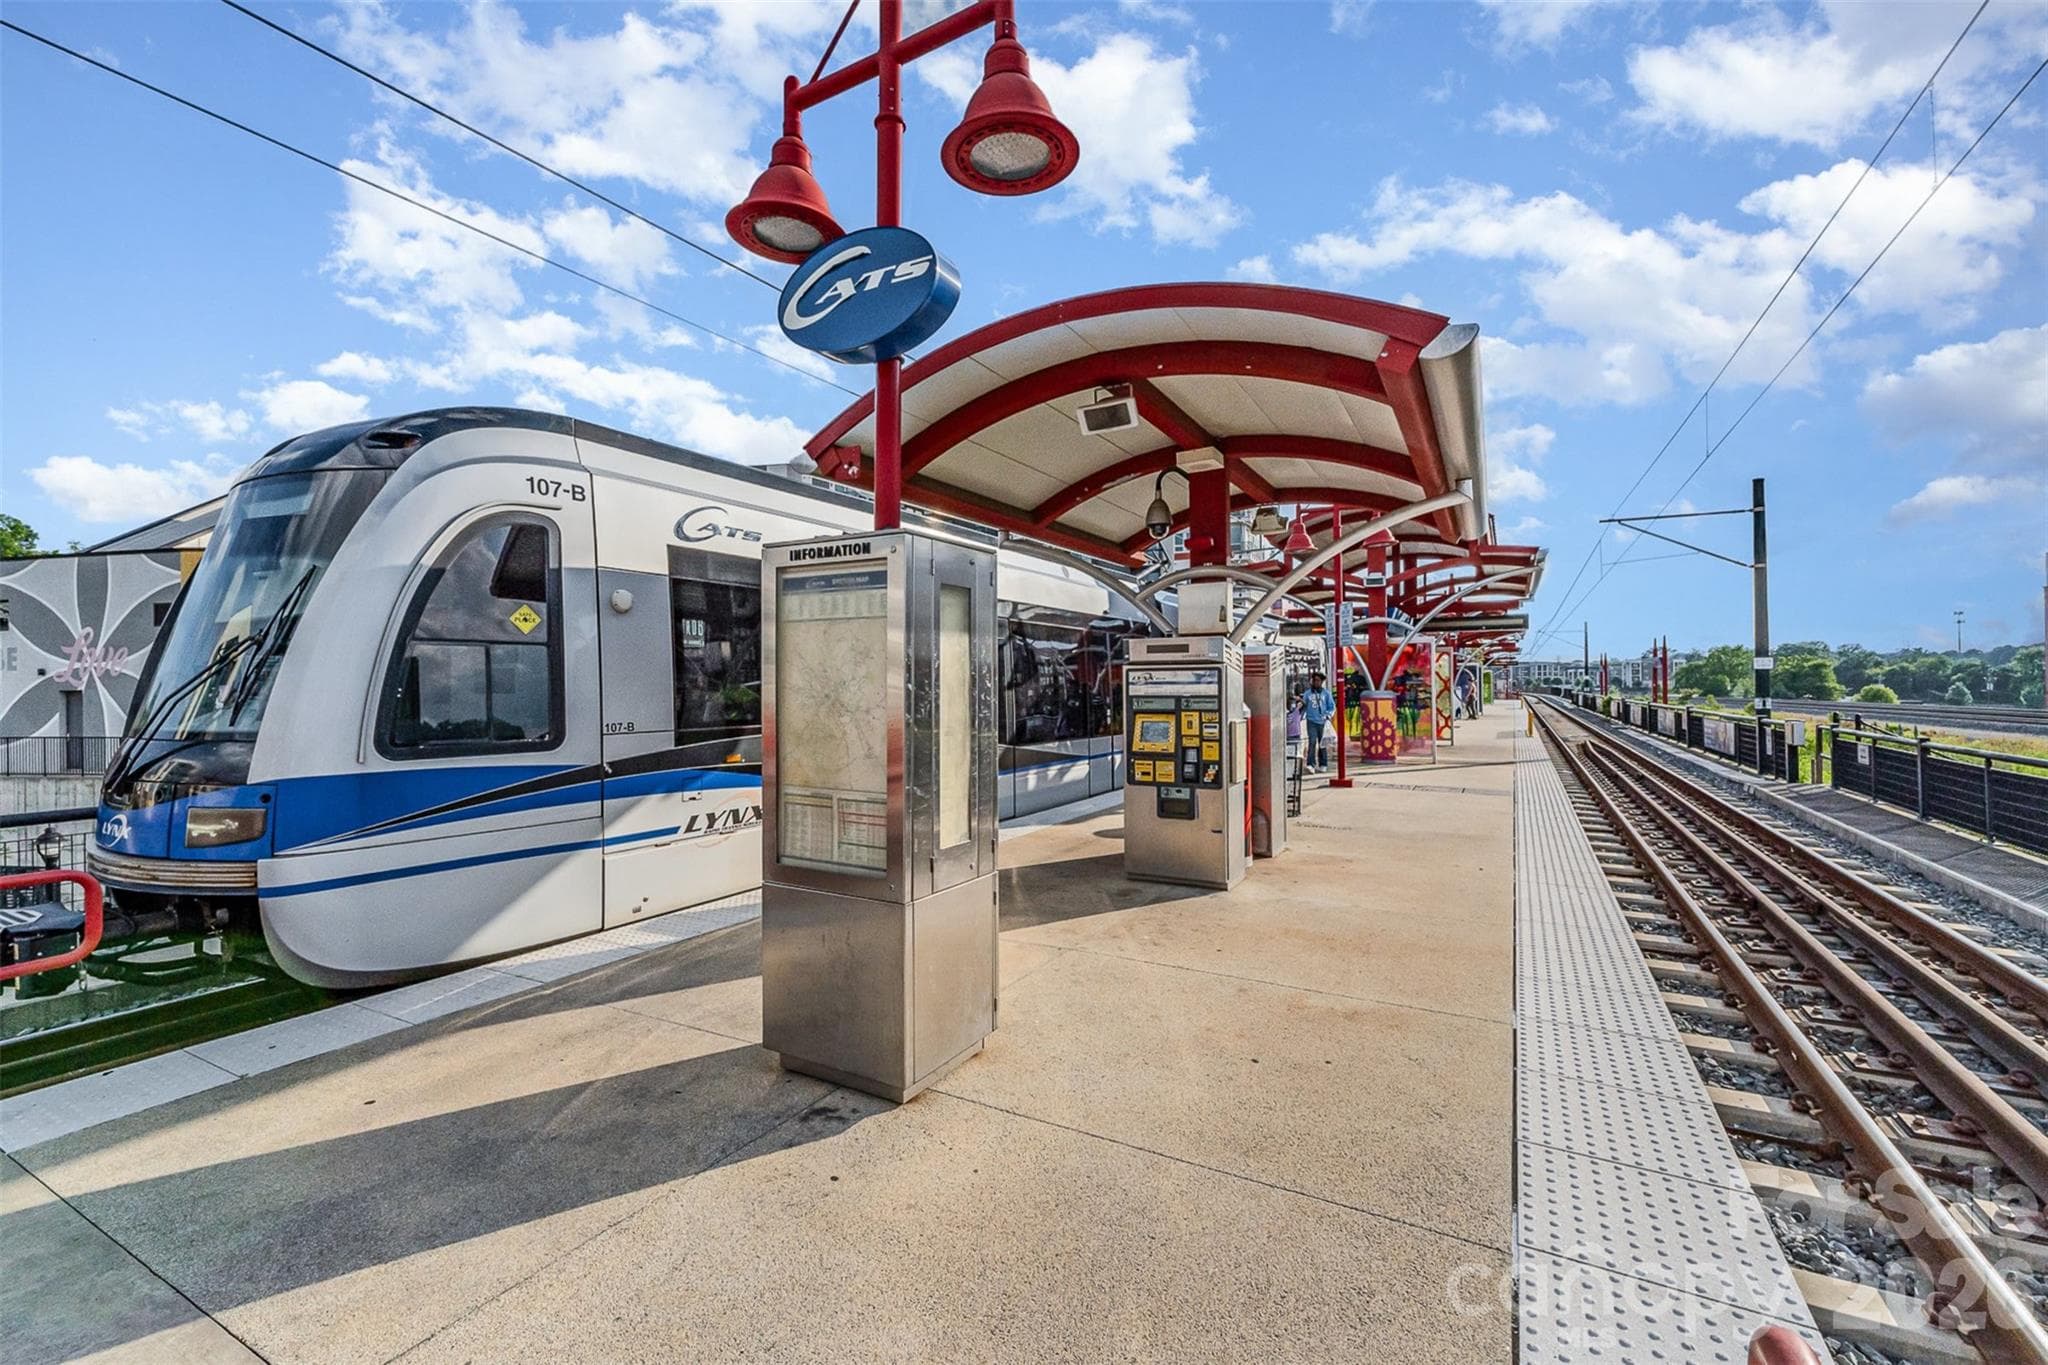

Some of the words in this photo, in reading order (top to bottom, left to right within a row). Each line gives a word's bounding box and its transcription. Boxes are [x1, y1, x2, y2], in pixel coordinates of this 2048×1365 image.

[783, 245, 934, 330] CATS
[526, 476, 586, 501] 107-B
[673, 506, 763, 543] CATS
[789, 541, 871, 561] INFORMATION
[53, 626, 129, 688] Love
[604, 722, 635, 733] 107-B
[102, 821, 132, 840] LYNX
[684, 804, 763, 834] LYNX
